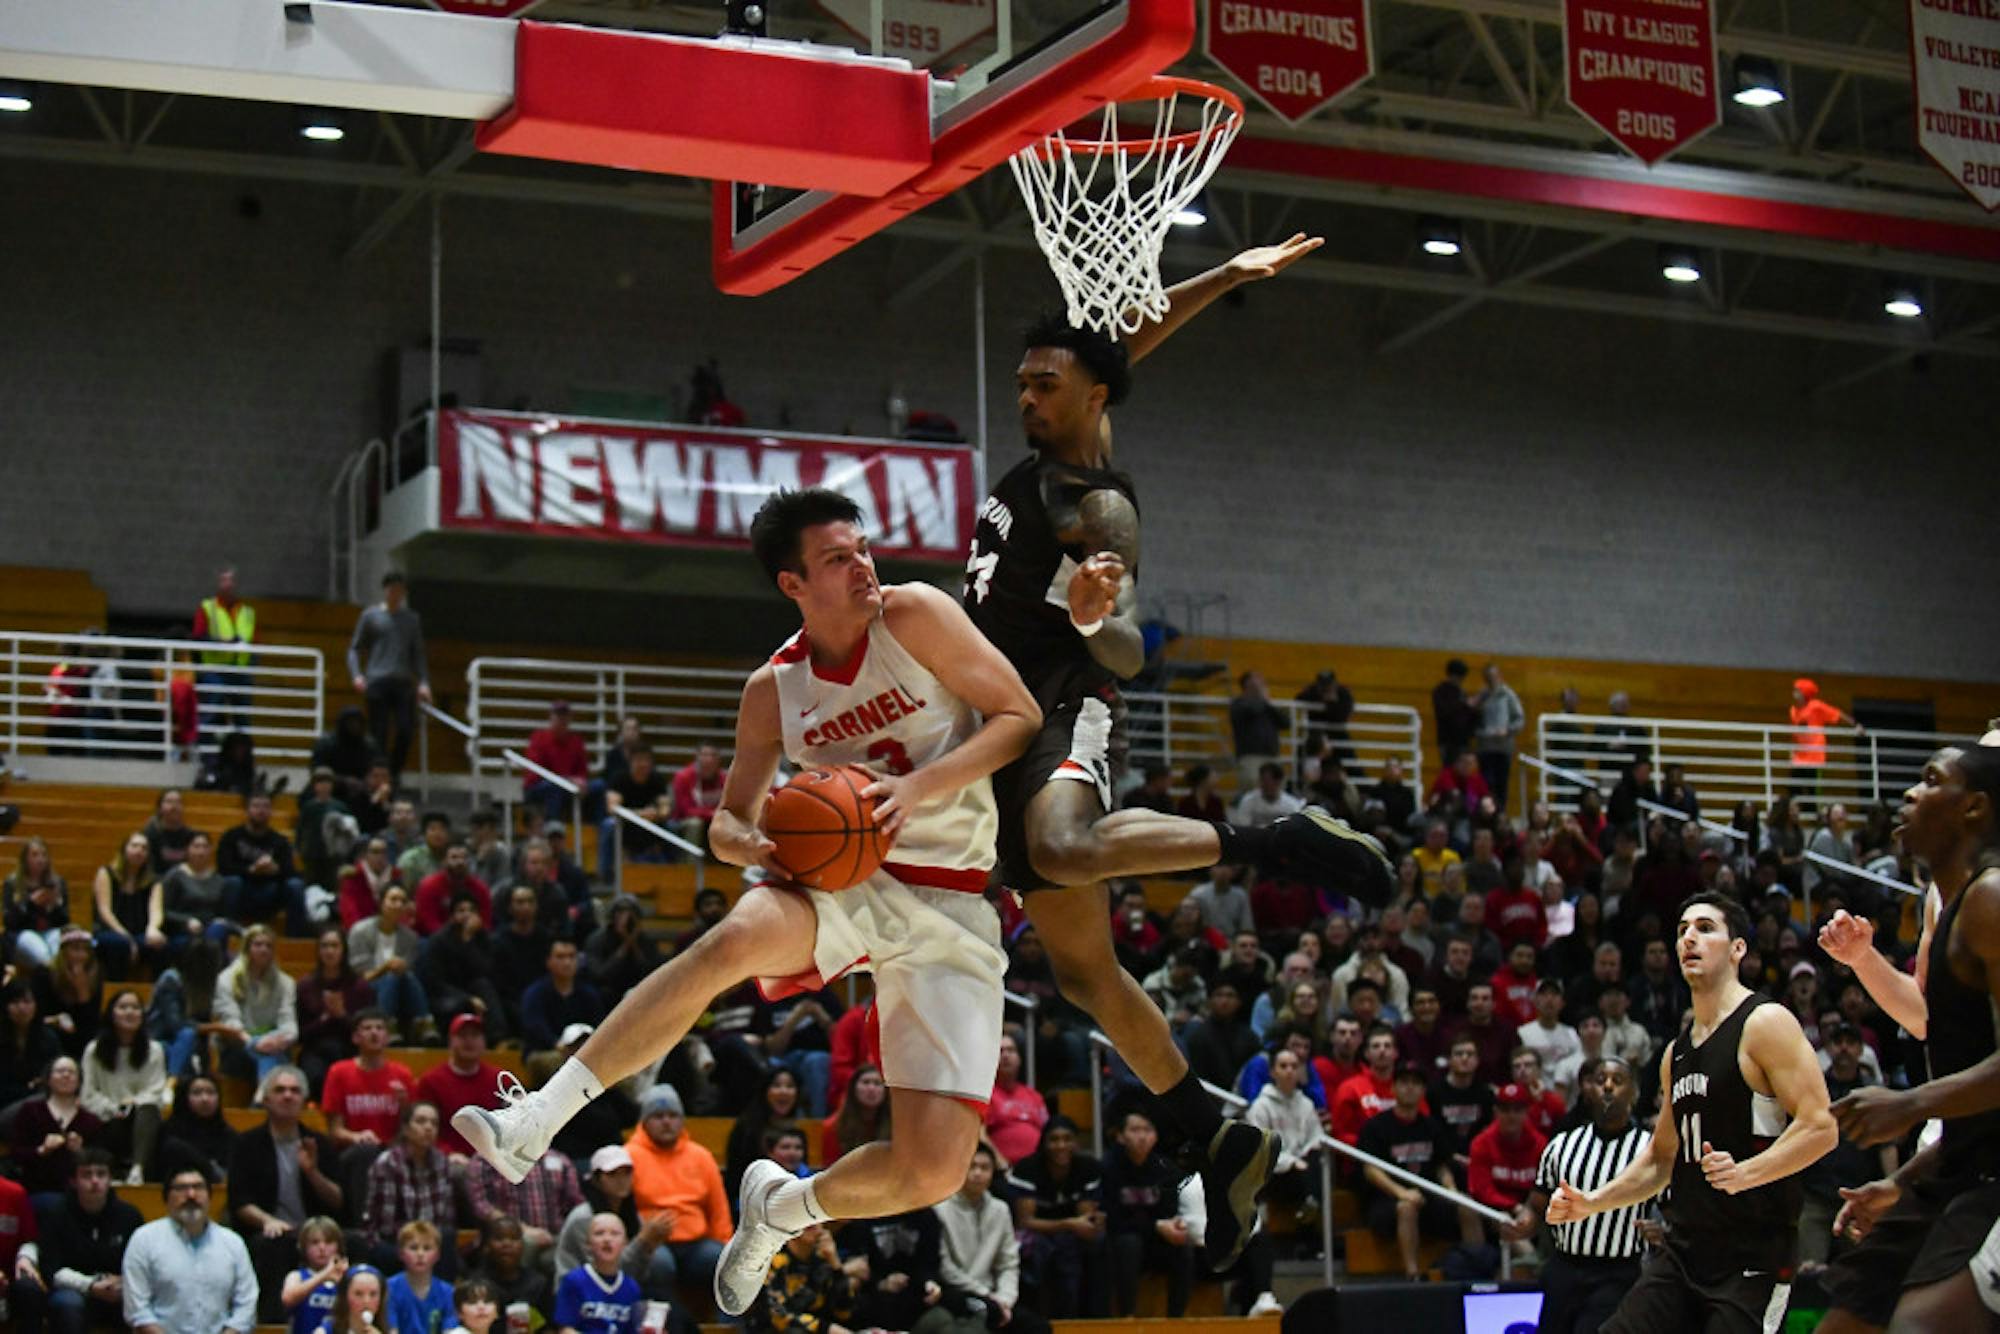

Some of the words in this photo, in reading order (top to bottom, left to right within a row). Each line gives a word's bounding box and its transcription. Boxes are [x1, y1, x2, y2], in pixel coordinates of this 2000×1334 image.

[1220, 2, 1357, 51] CHAMPIONS
[1584, 9, 1616, 36] IVY
[1623, 15, 1699, 47] LEAGUE
[1920, 0, 2000, 20] RNE
[1258, 64, 1323, 97] 2004
[1579, 48, 1706, 97] CHAMPIONS
[1617, 108, 1676, 141] 2005
[455, 420, 960, 551] NEWMAN
[1681, 1113, 1702, 1163] 11
